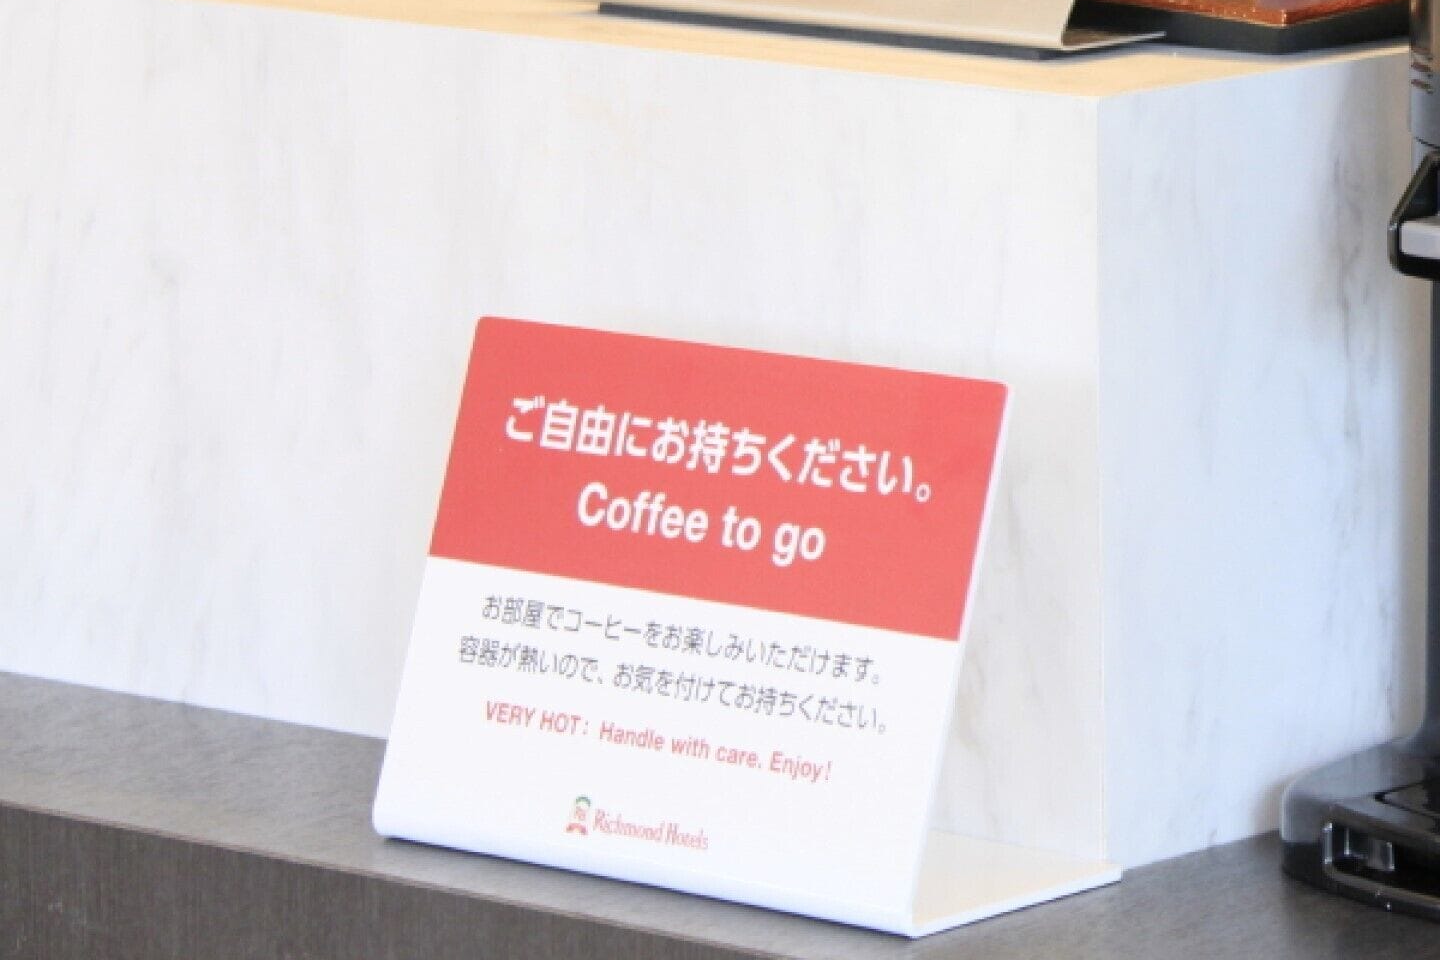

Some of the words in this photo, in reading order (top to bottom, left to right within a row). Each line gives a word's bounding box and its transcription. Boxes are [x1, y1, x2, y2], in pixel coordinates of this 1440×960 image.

[504, 395, 931, 503] ご自由にお持ちください。
[577, 481, 709, 541] Coffee
[722, 506, 761, 549] to
[772, 522, 826, 567] go
[482, 595, 882, 685] お部屋でコーヒーをお楽しみいただけます。
[486, 700, 536, 728] VERY
[539, 710, 589, 736] HOT:
[600, 721, 665, 751] Handle
[671, 736, 710, 760] with
[715, 745, 762, 769] care.
[769, 751, 833, 783] Enjoy!
[593, 808, 665, 842] Richmond
[664, 821, 709, 851] Hotels
